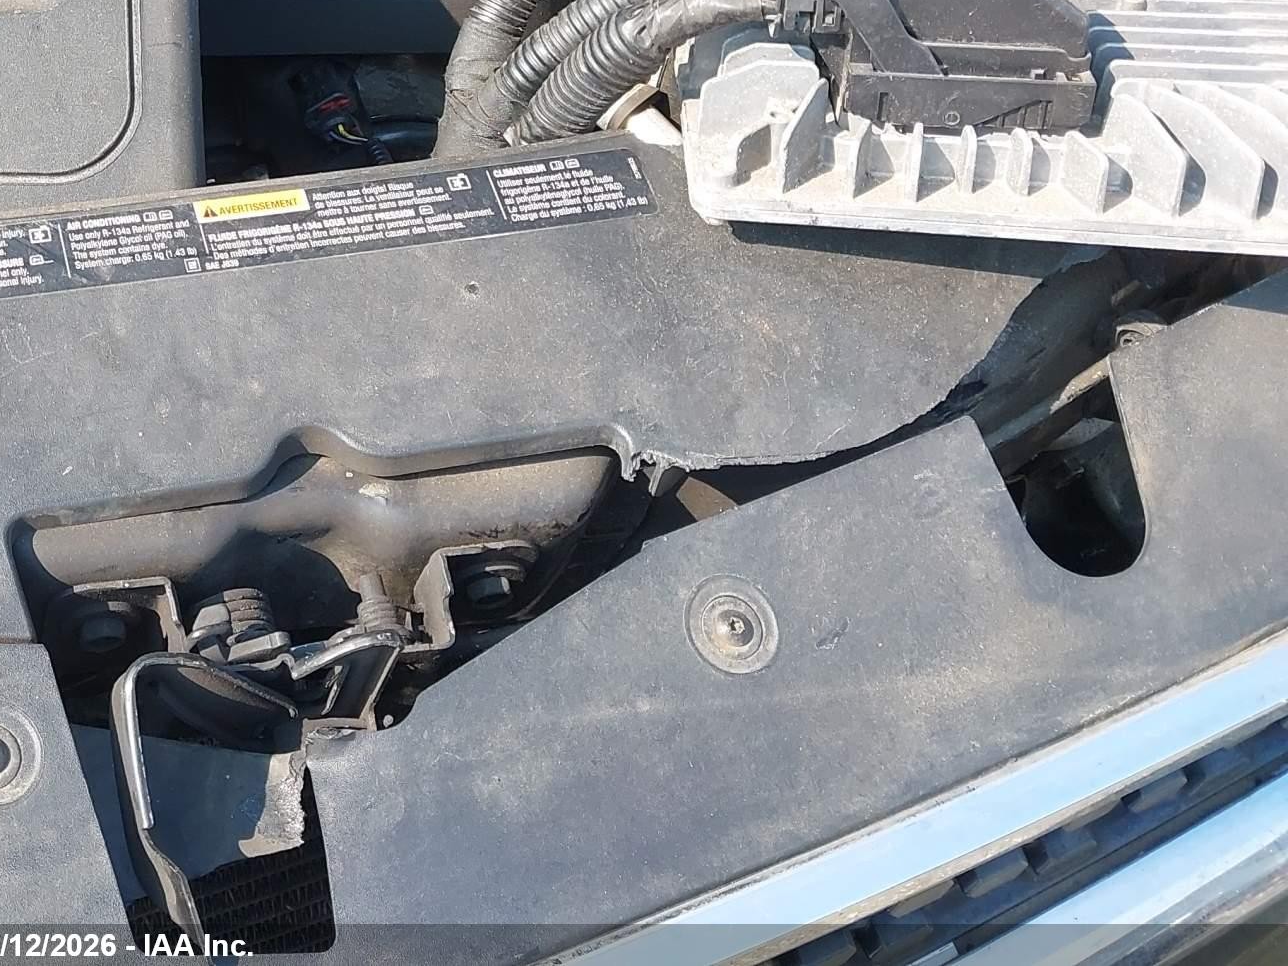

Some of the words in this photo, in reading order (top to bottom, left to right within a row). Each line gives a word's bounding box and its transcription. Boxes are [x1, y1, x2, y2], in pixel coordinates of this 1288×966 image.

[492, 164, 546, 178] CLIMATISEUR
[219, 198, 297, 215] AVERTISSEMENT
[66, 221, 80, 230] AIR
[82, 213, 141, 228] CONDITIONING
[68, 233, 83, 241] Use
[85, 230, 100, 239] only
[102, 226, 131, 237] R-134a
[132, 220, 173, 233] Refrigerant
[175, 218, 190, 228] and
[207, 231, 237, 242] FLUIDE
[323, 218, 345, 227] SOUS
[347, 214, 373, 224] HAUTE
[374, 208, 415, 220] PRESSION
[2, 229, 25, 239] injury.
[119, 234, 142, 245] Glycol
[143, 233, 153, 241] oil
[154, 230, 172, 242] (PAG
[268, 242, 309, 252] d'entretien
[354, 231, 384, 242] peuvent
[385, 229, 410, 237] causer
[72, 251, 87, 259] The
[89, 248, 116, 258] system
[117, 244, 150, 254] contains
[151, 242, 168, 251] dye.
[75, 259, 103, 270] System
[154, 251, 164, 260] kg
[205, 261, 220, 269] SAE
[10, 268, 29, 276] only.
[20, 276, 44, 284] injury.
